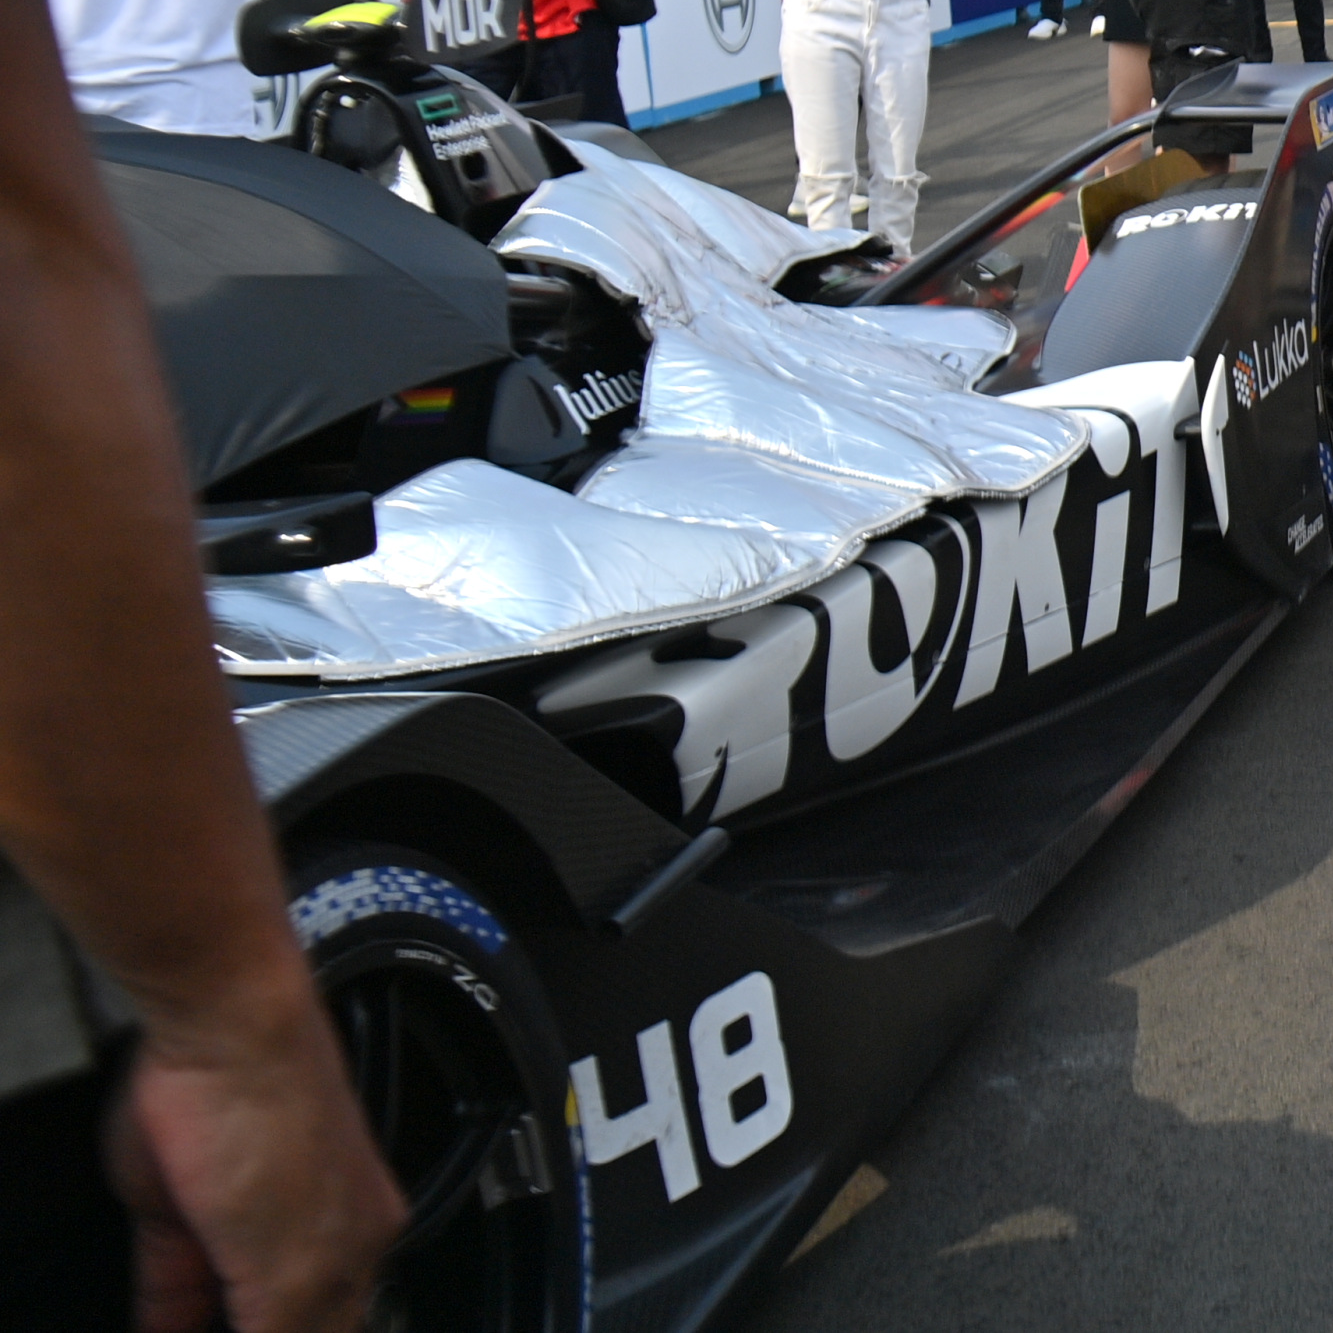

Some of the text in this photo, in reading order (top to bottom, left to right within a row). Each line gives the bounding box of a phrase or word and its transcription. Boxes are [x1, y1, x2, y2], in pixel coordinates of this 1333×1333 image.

[425, 118, 470, 142] Hewlett
[432, 134, 489, 161] Enterprise
[1252, 317, 1309, 402] Lukka
[552, 369, 642, 436] Julius
[568, 969, 793, 1204] 48
